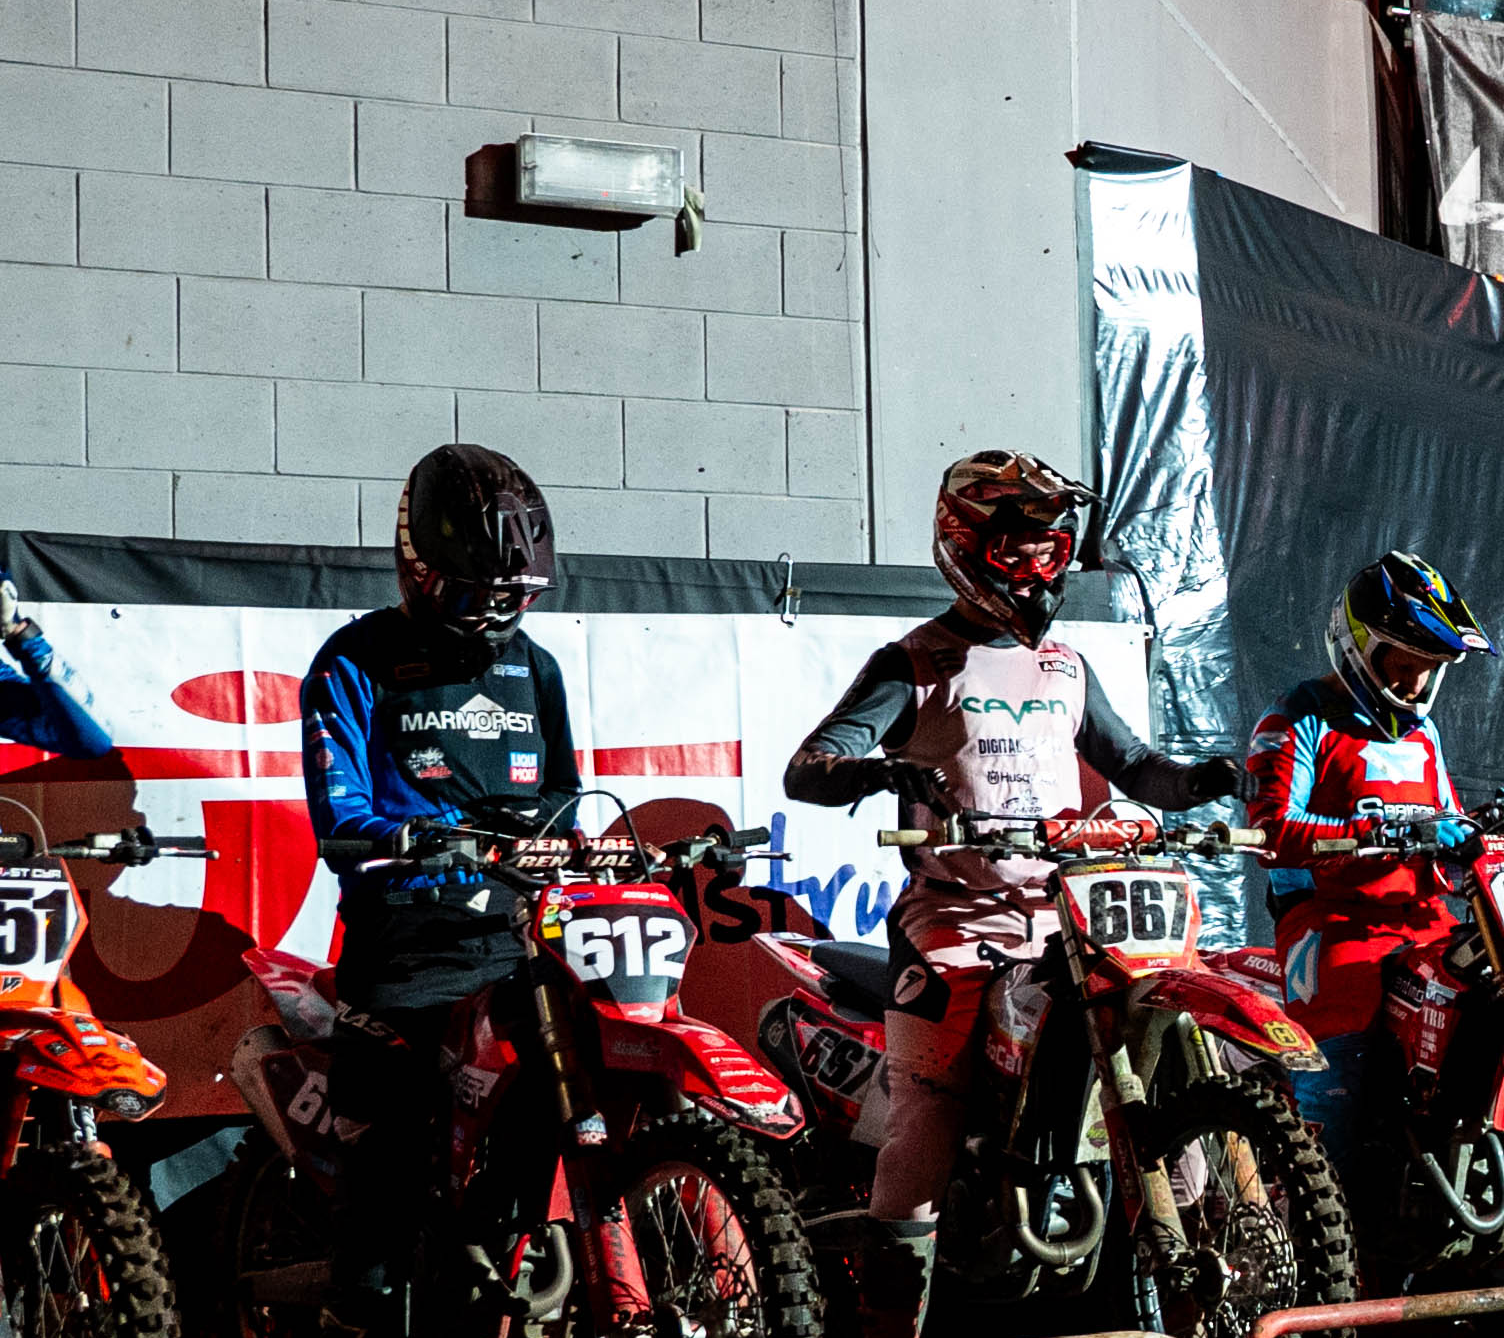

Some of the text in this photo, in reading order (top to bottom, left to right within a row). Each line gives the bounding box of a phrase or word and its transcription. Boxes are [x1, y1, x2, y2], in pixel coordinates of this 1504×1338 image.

[400, 710, 535, 734] MARMOREST
[510, 767, 538, 782] MOLY
[517, 838, 634, 852] RENHAL
[1089, 879, 1189, 945] 667
[563, 915, 687, 982] 612
[1242, 955, 1282, 978] HON
